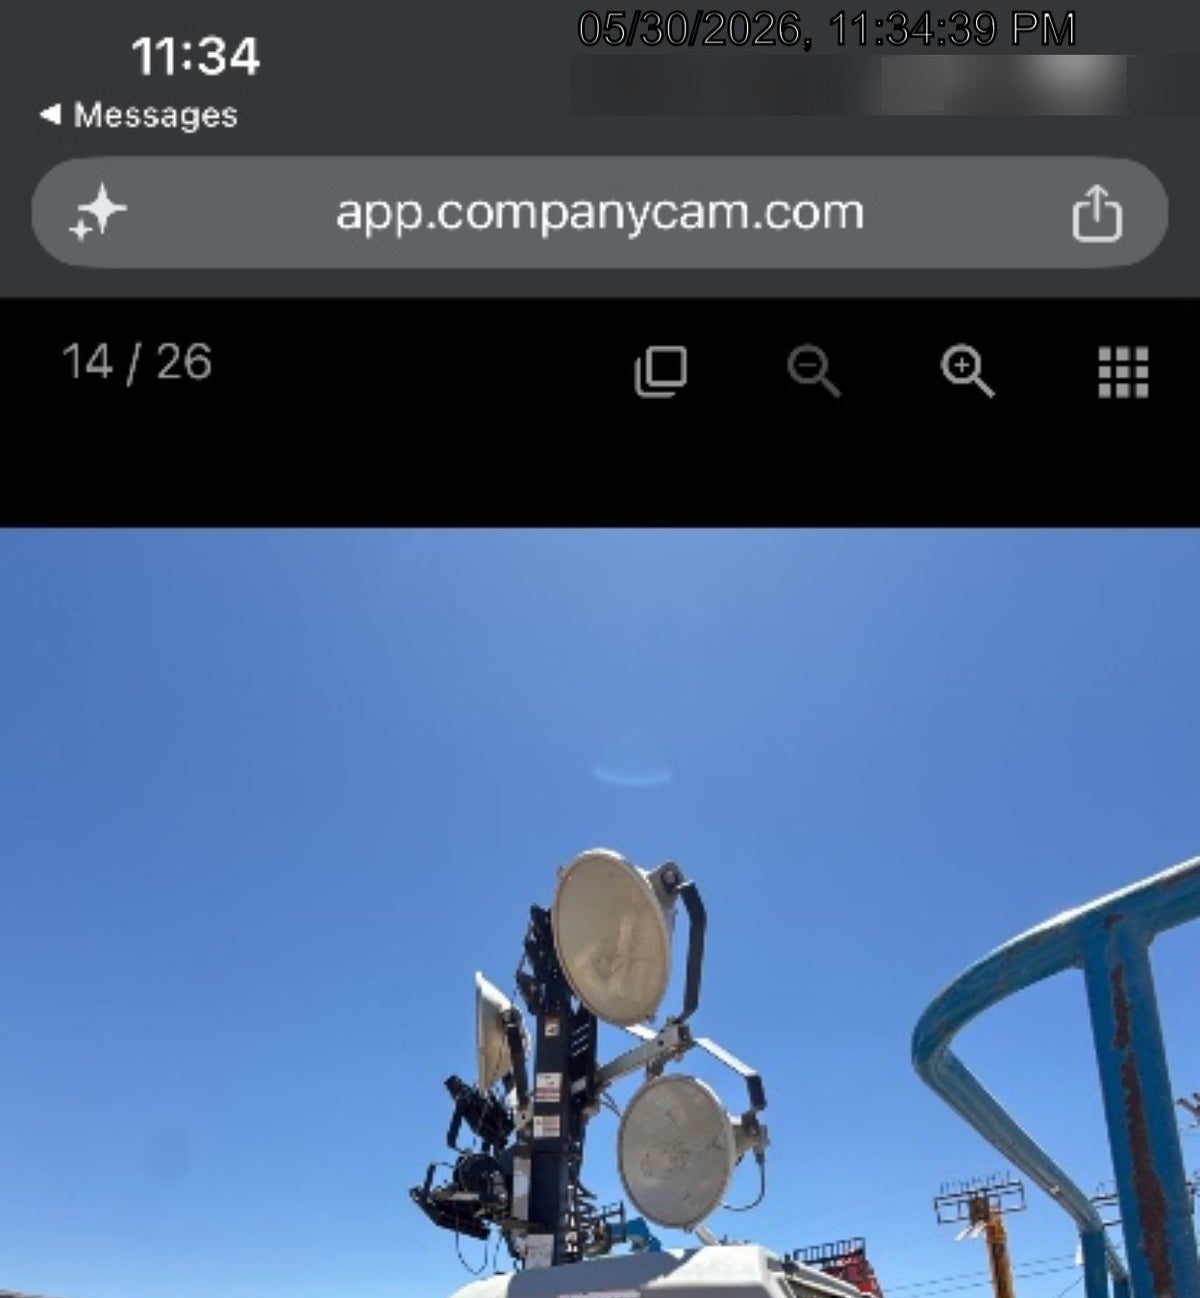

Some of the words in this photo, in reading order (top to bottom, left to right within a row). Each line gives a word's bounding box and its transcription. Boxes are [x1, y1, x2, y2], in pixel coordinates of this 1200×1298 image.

[131, 36, 261, 76] 11:34
[74, 101, 238, 134] Messages
[337, 195, 864, 239] app.companycam.com
[63, 343, 113, 387] 14
[157, 343, 212, 387] 26
